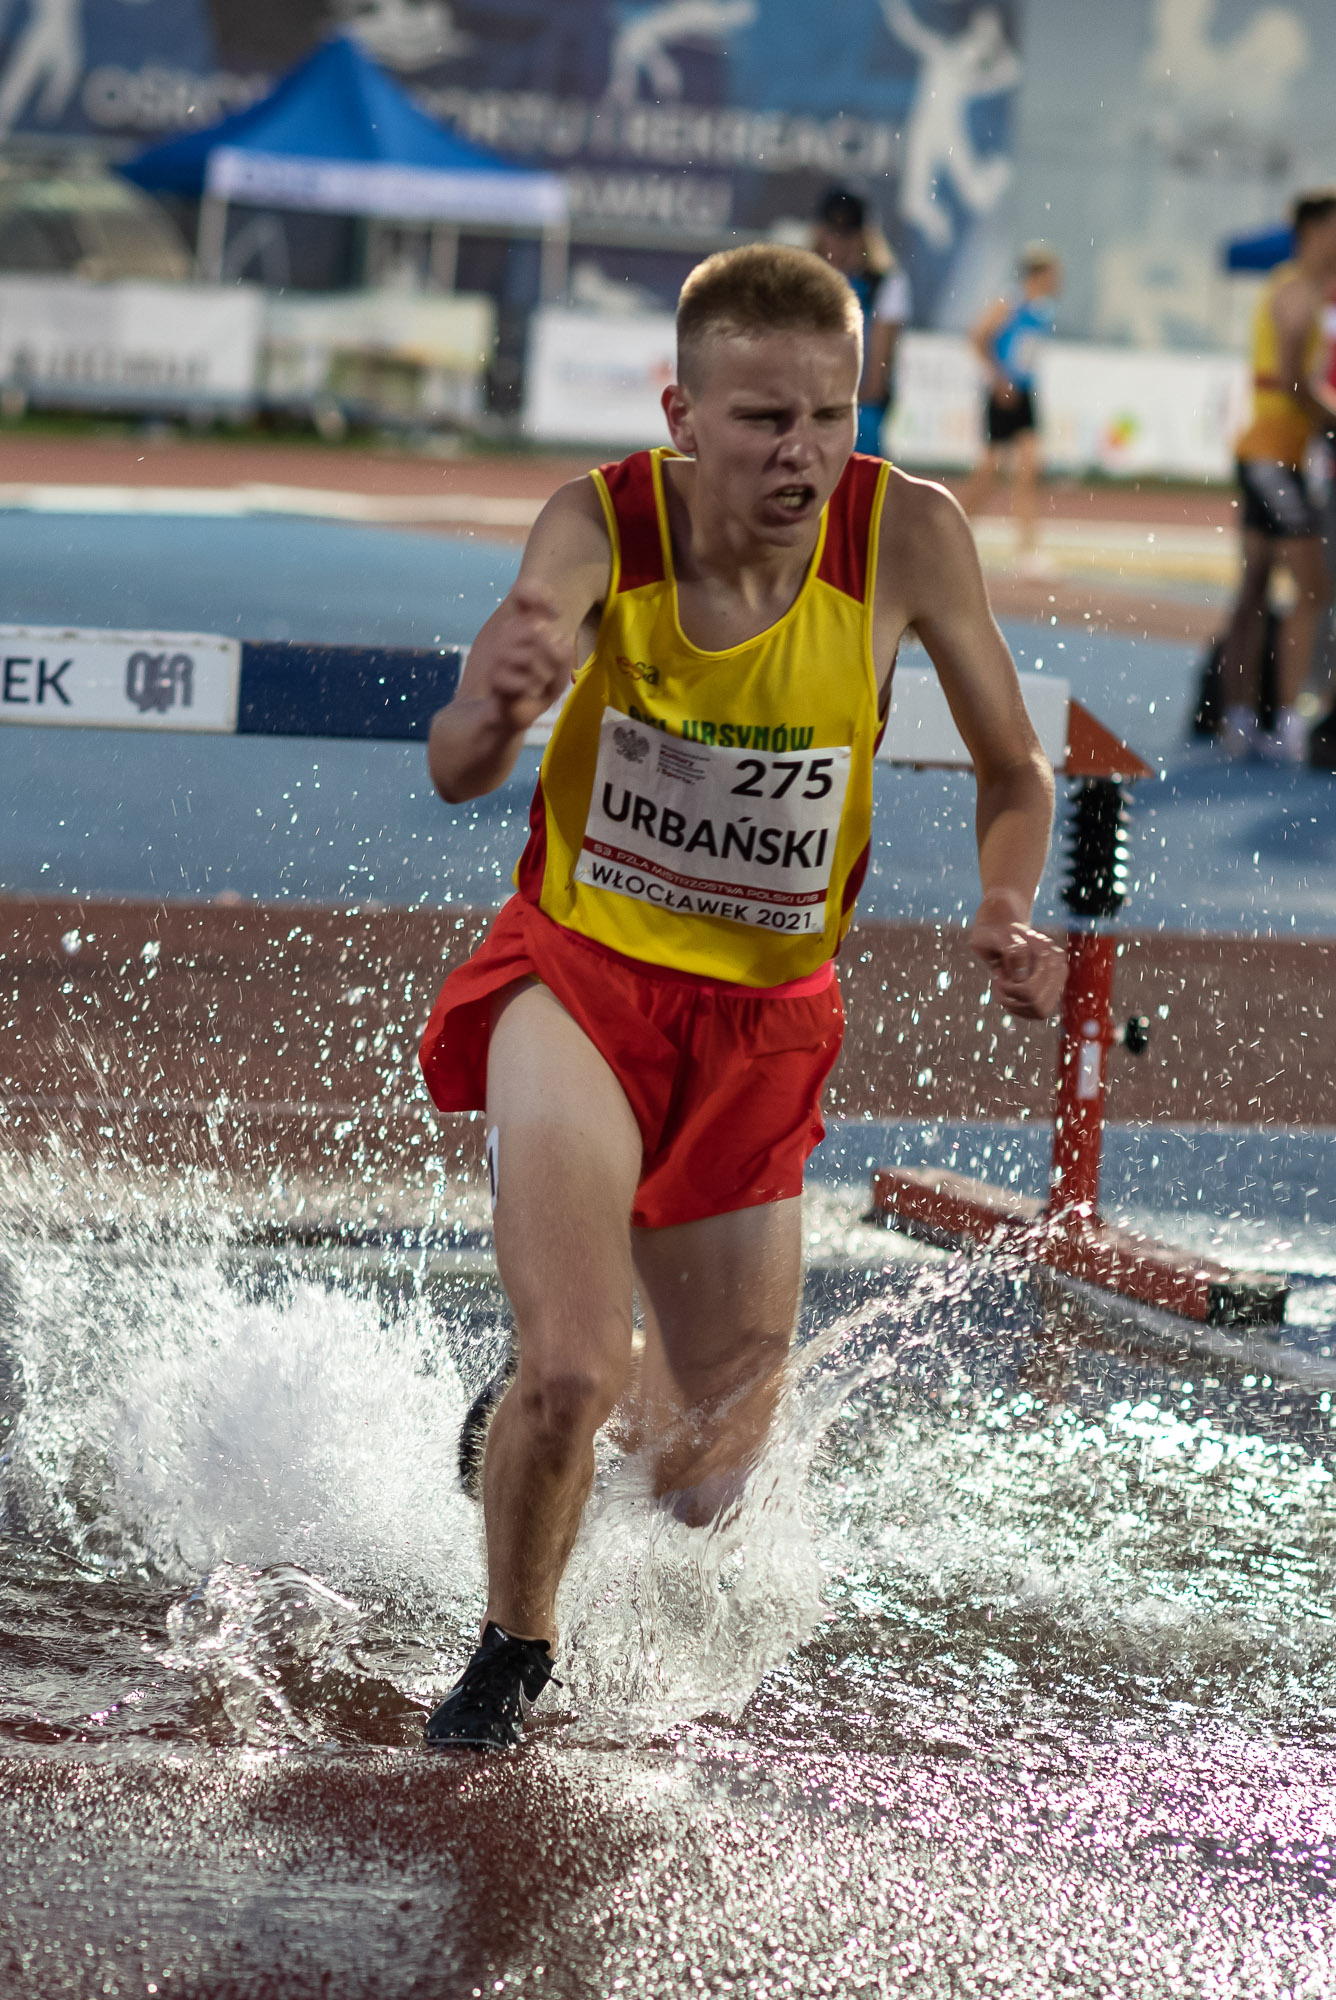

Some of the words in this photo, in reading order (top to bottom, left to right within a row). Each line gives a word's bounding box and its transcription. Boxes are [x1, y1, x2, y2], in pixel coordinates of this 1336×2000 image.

[0, 656, 73, 706] EK
[682, 720, 815, 753] URSYNÓW
[730, 758, 833, 800] 275
[602, 782, 829, 868] URBAŃSKI
[592, 862, 750, 922] WŁOCŁAWEK
[756, 908, 811, 930] 2021
[616, 852, 650, 870] PZLA
[651, 865, 744, 896] MISTRZOSTWA
[746, 888, 794, 904] POLSKI
